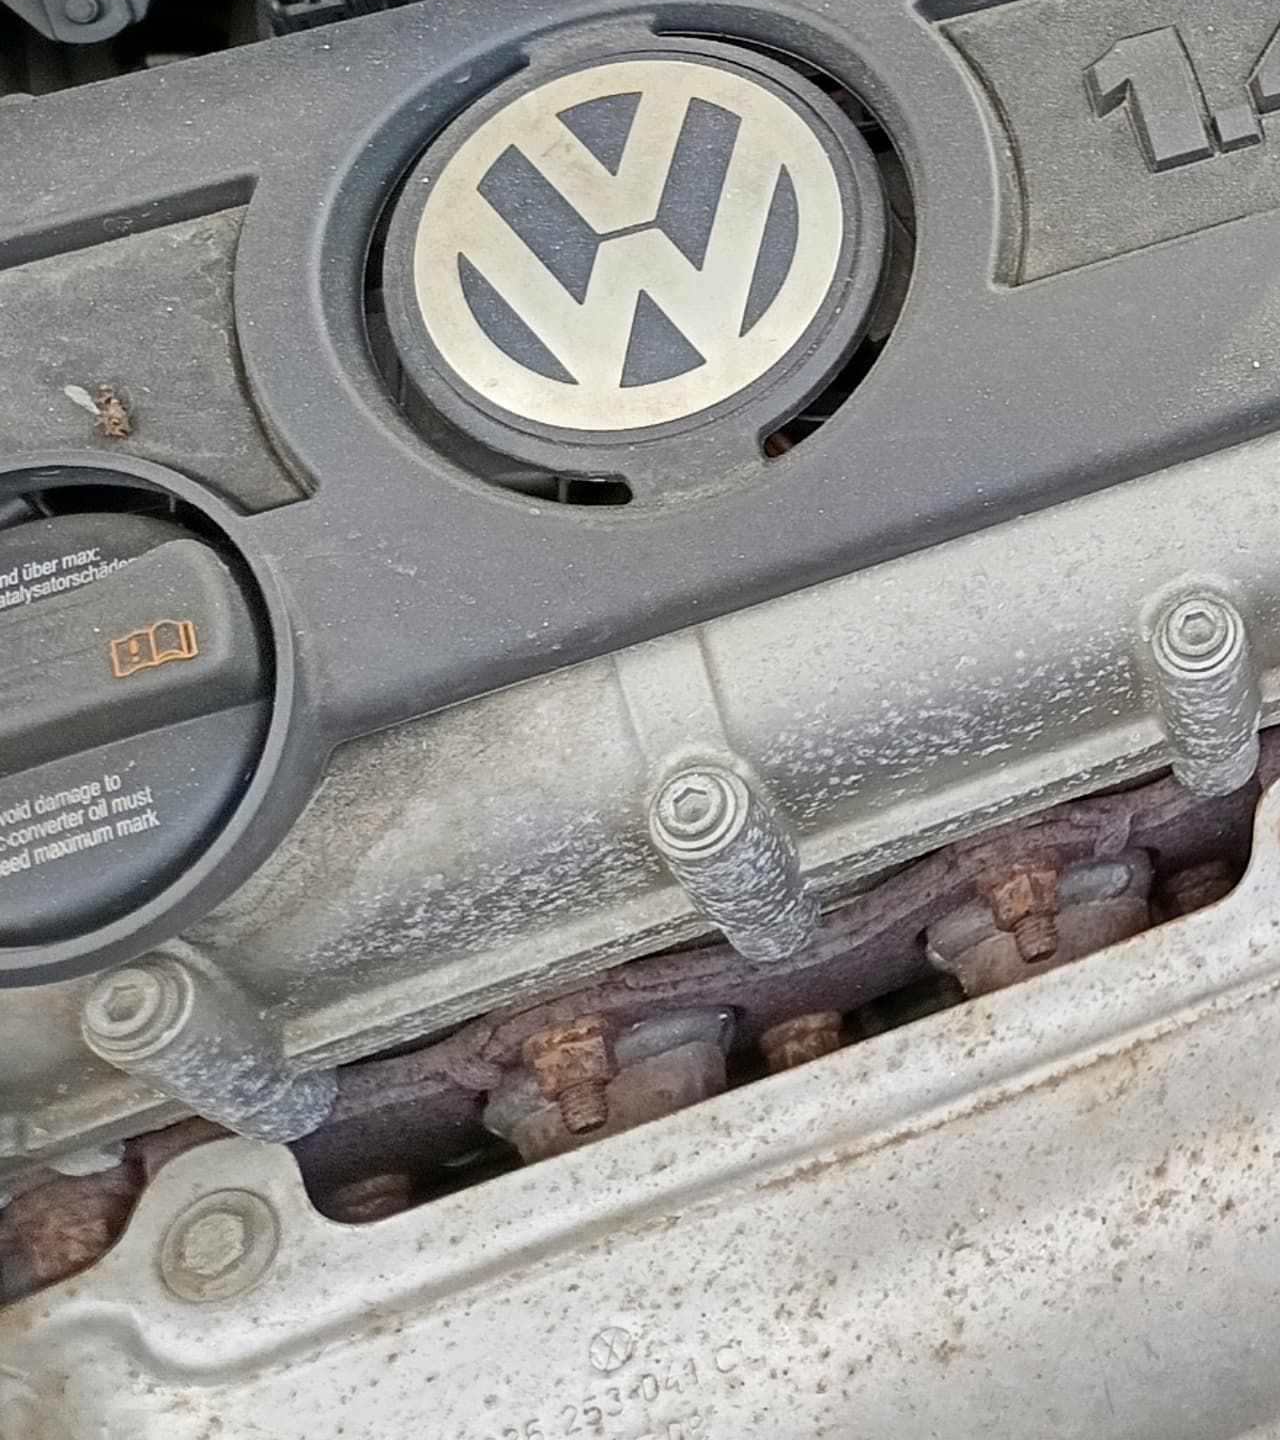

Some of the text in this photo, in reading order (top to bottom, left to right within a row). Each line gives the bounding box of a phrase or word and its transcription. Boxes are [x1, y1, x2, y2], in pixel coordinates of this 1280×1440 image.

[414, 60, 844, 431] VW
[34, 782, 101, 814] damage
[104, 774, 121, 792] to
[88, 798, 109, 821] oil
[111, 785, 154, 814] must
[34, 825, 114, 864] maximum
[116, 809, 160, 838] mark
